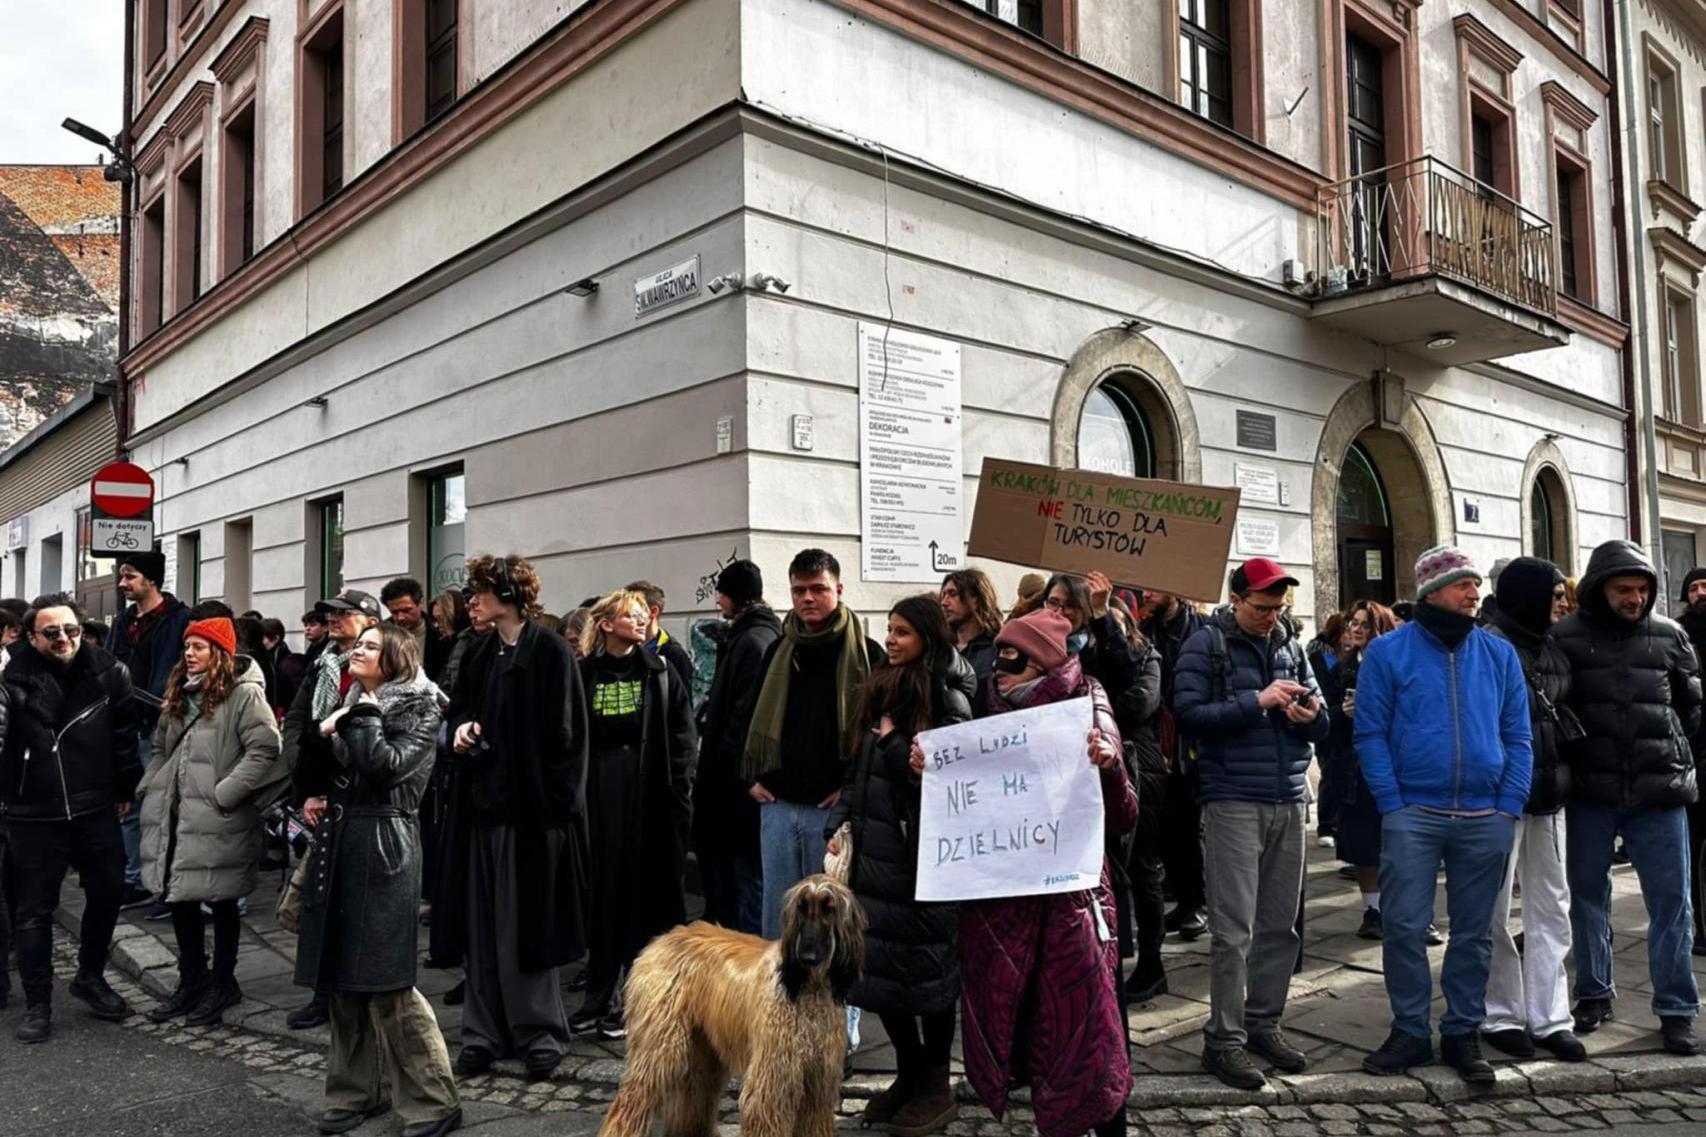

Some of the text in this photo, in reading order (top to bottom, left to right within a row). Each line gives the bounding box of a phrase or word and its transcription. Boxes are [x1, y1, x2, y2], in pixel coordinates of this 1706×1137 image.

[868, 421, 909, 434] DEKORACJA
[991, 471, 1222, 525] KRAKÓW DLA MIESZKAŃCÓW,
[98, 521, 147, 531] Nie dotyczy
[1038, 500, 1168, 537] NIE TYLKO DLA
[937, 553, 957, 565] 20m
[933, 746, 966, 771] BEZ
[947, 772, 1029, 819] NIE MA
